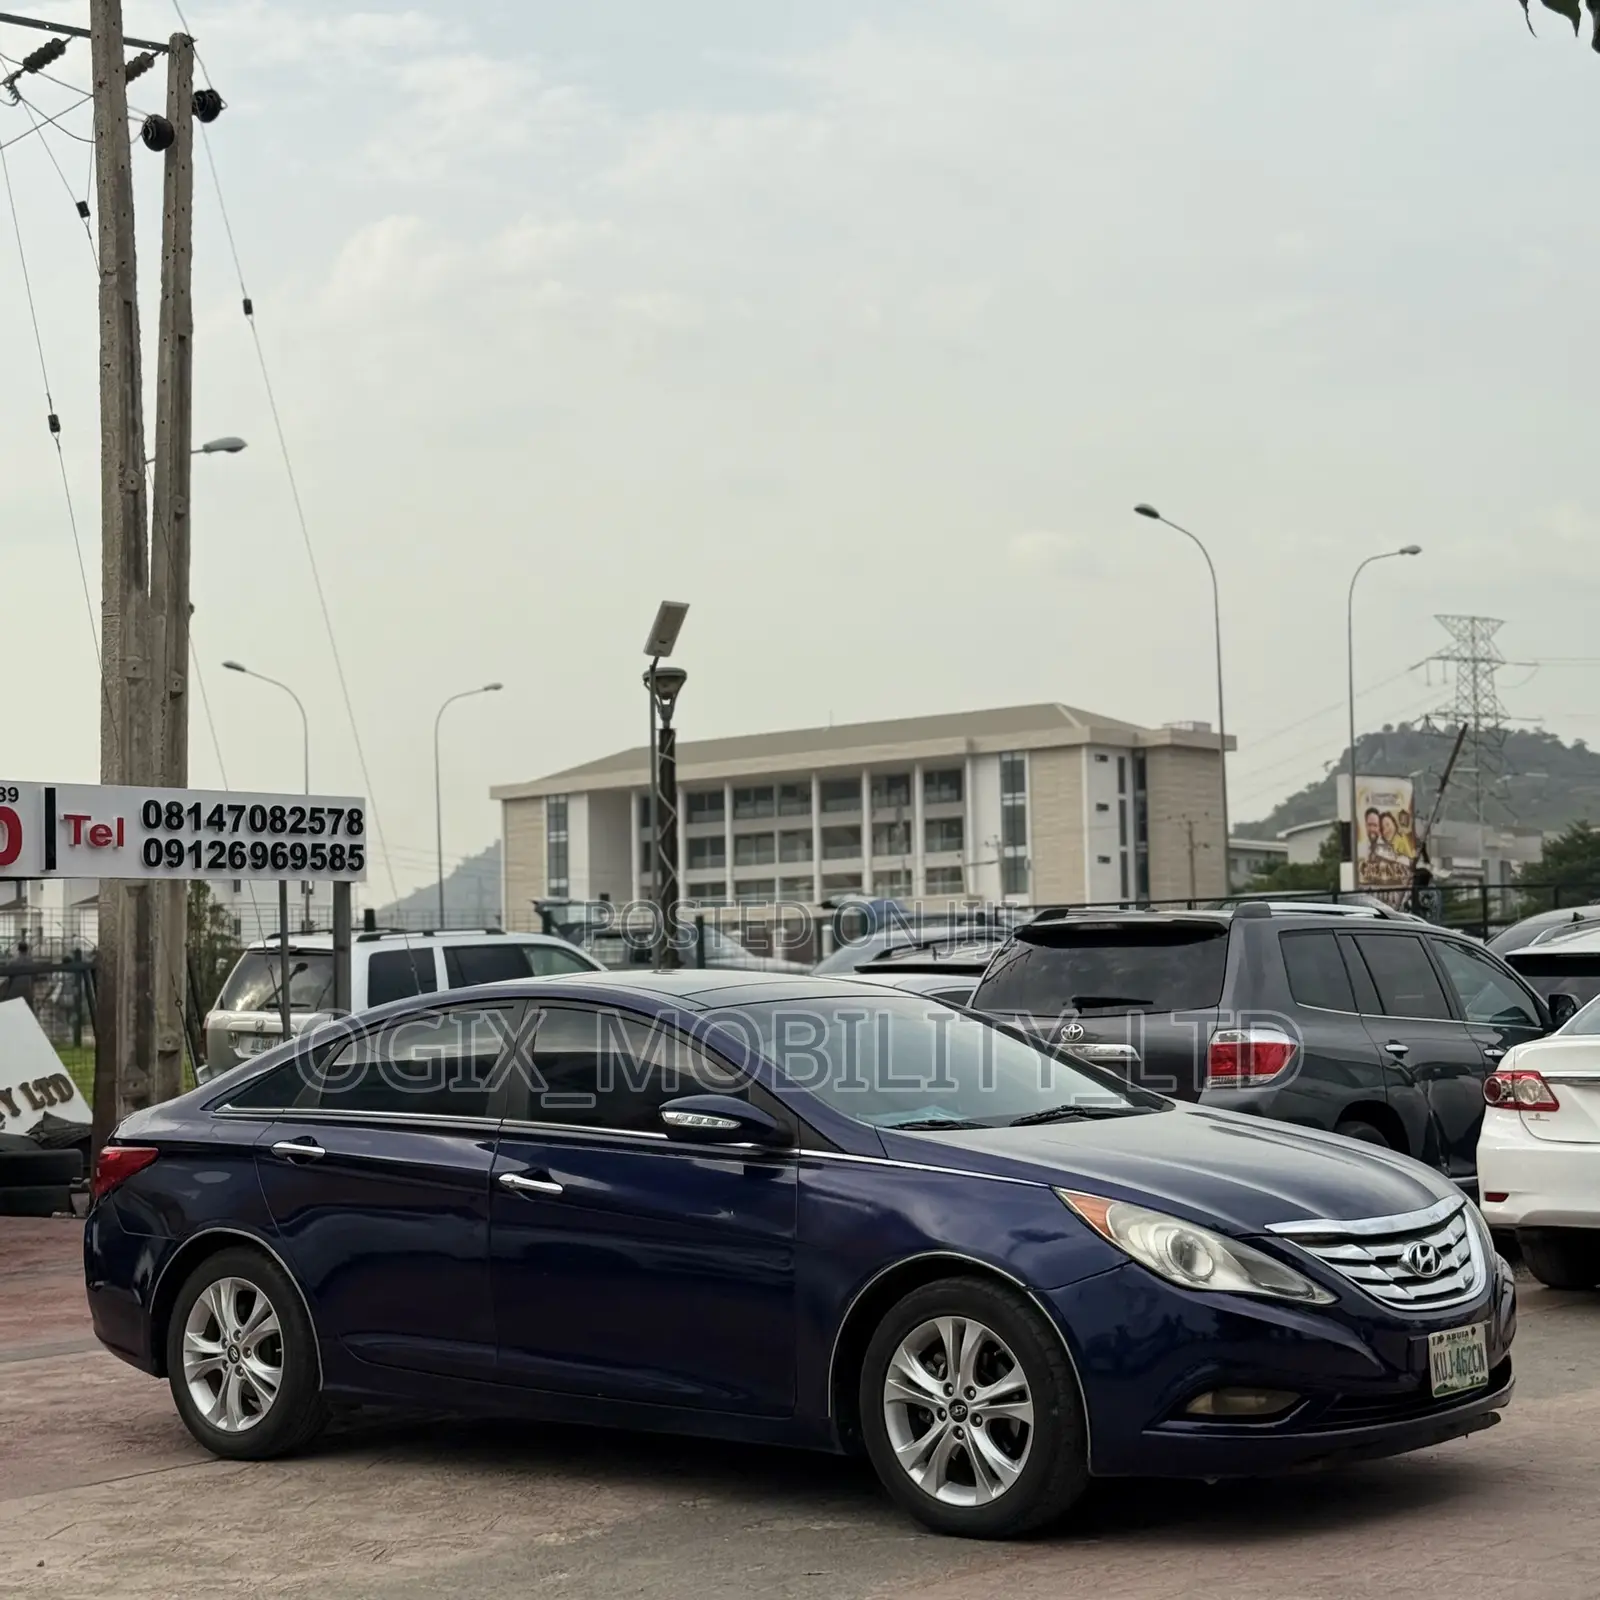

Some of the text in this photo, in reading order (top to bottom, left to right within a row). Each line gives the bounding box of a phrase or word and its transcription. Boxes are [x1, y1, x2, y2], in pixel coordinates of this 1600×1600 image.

[63, 814, 125, 847] Tel
[141, 799, 364, 836] 08147082578
[142, 837, 365, 872] 09126969585
[19, 1072, 75, 1111] LTD
